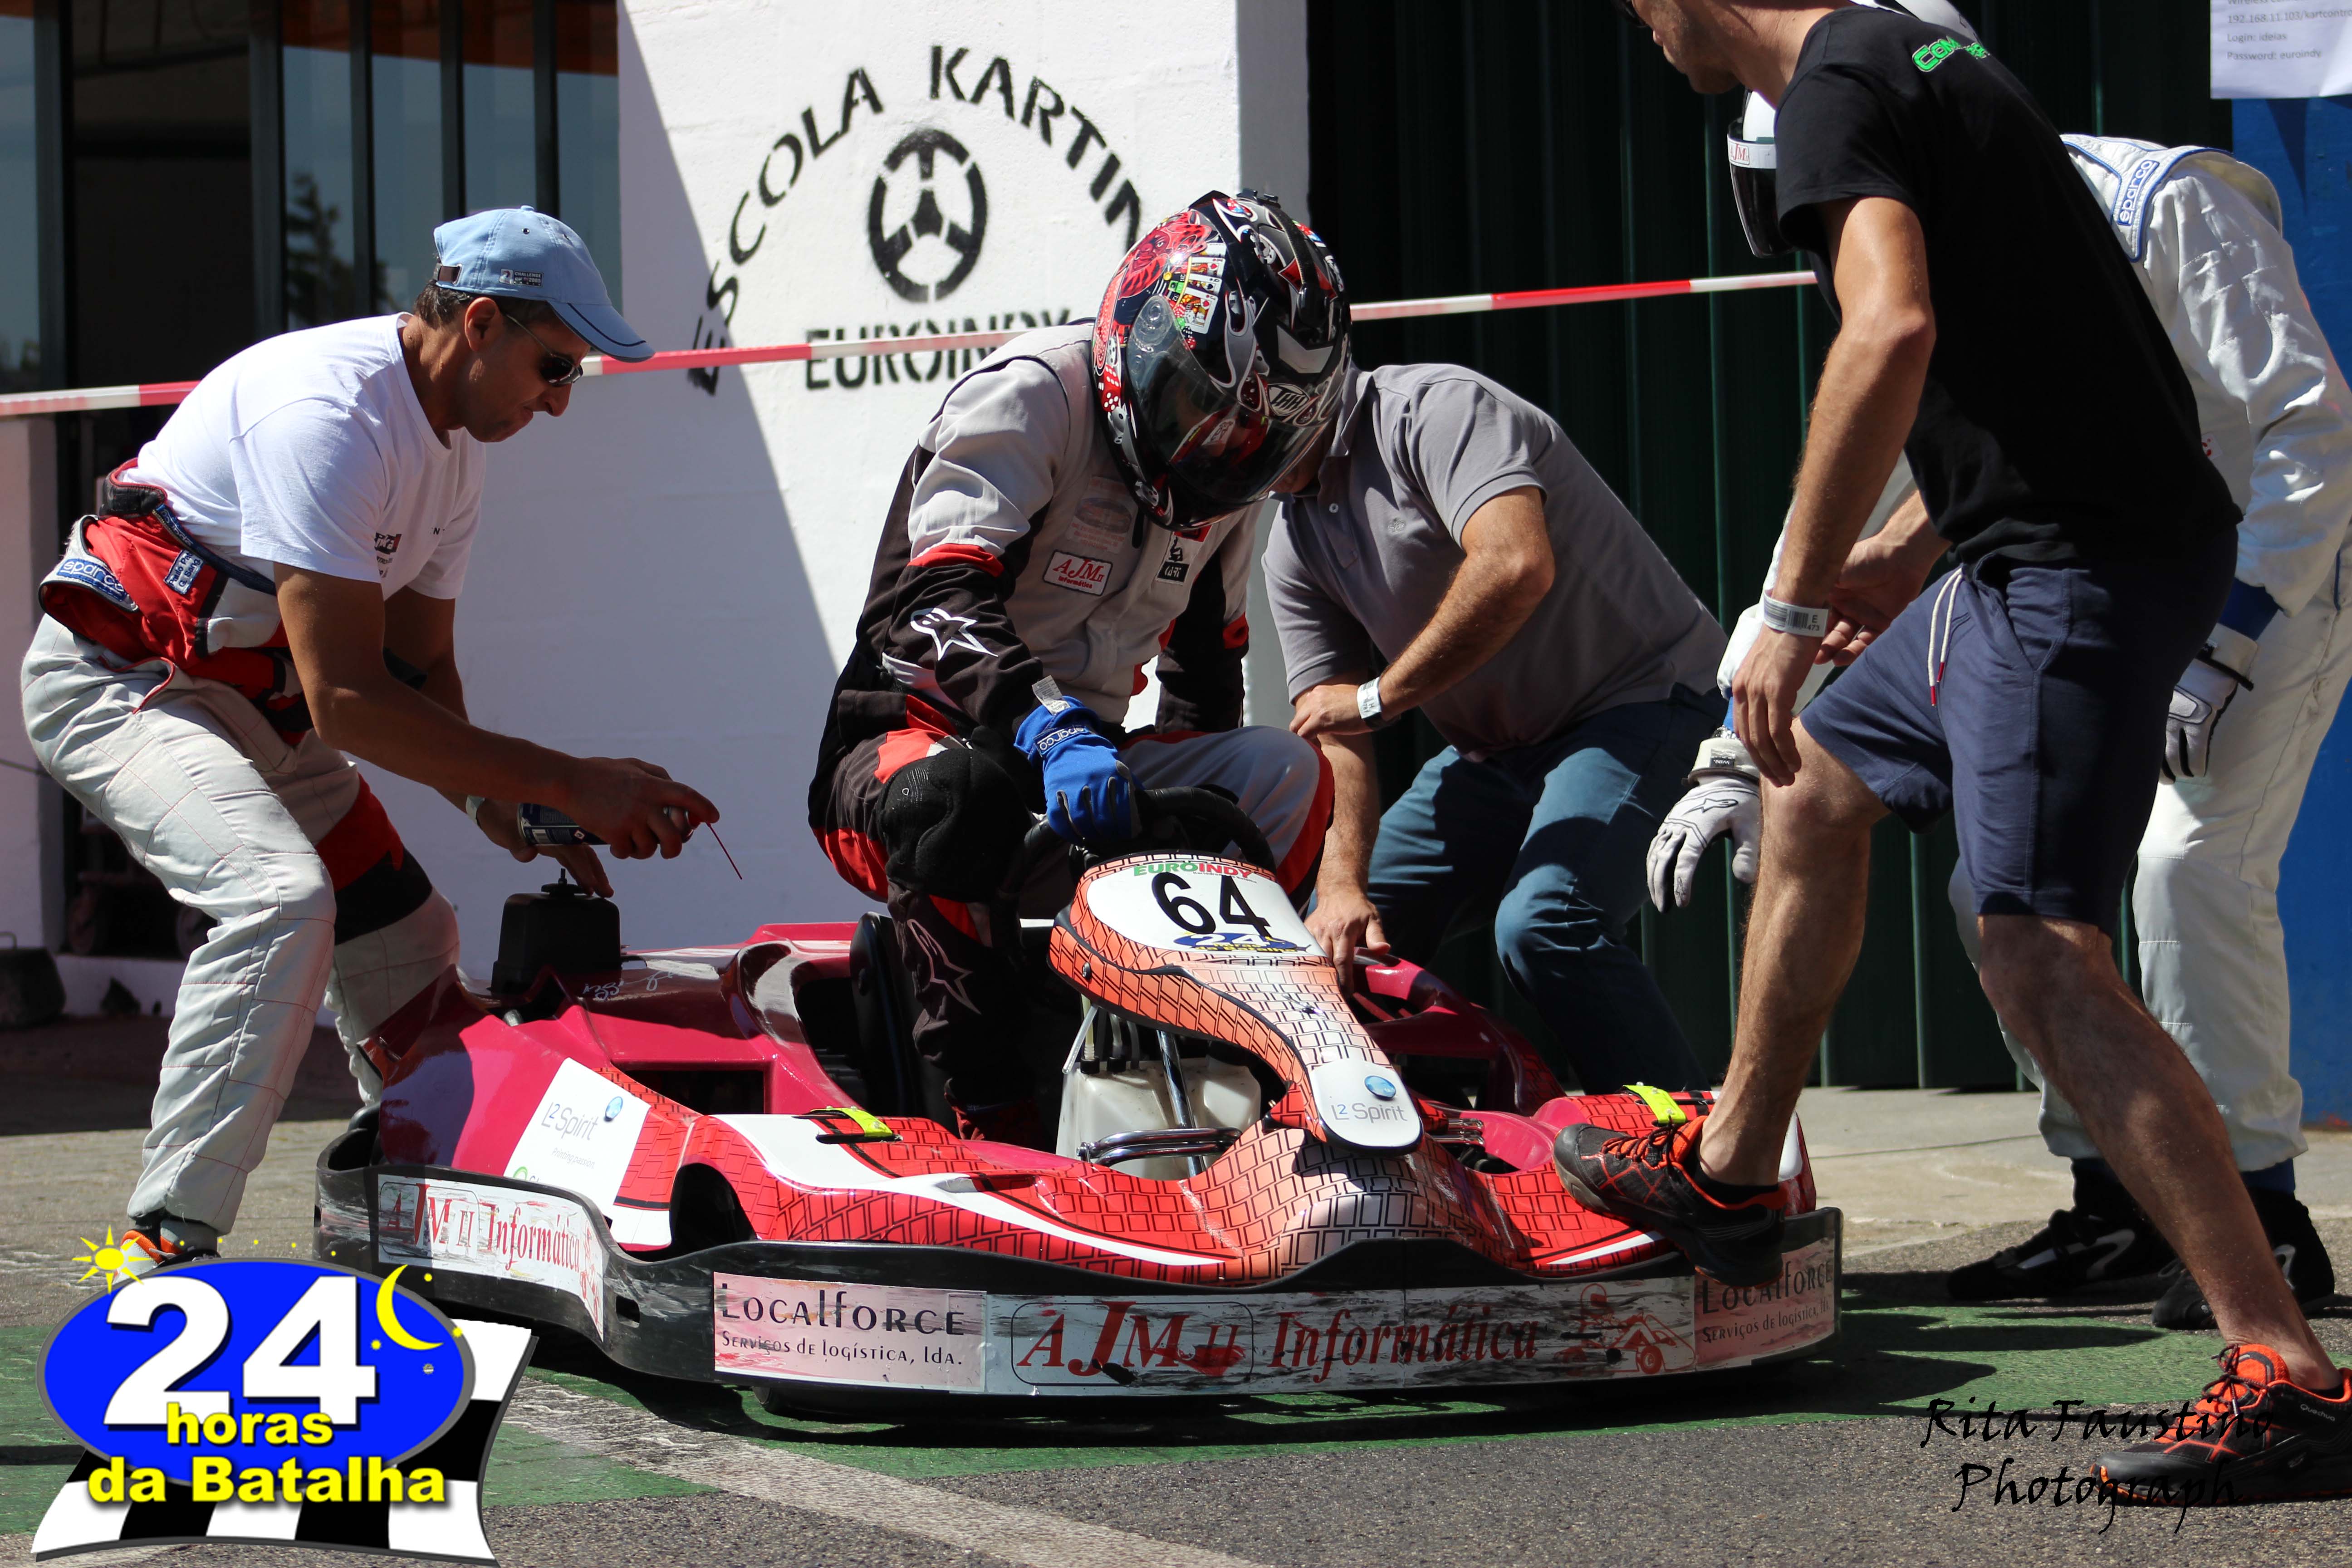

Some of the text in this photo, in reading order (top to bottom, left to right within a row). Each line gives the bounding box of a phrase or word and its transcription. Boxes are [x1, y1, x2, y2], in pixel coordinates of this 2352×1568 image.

[2227, 32, 2287, 43] Login: ideias
[2227, 49, 2322, 60] Password: euroindy
[2119, 160, 2153, 223] sparco
[686, 44, 1143, 396] ESCOLA KARTIN
[61, 561, 124, 593] sparco
[1134, 862, 1252, 878] EUROINDY
[1152, 872, 1273, 938] 64
[1190, 933, 1271, 946] 24
[555, 1107, 599, 1141] Spirit
[1352, 1102, 1408, 1123] Spirit
[552, 1147, 574, 1164] Printing
[479, 1199, 580, 1270] Informática
[1017, 1301, 1190, 1377] AJM
[1267, 1305, 1539, 1383] Informática
